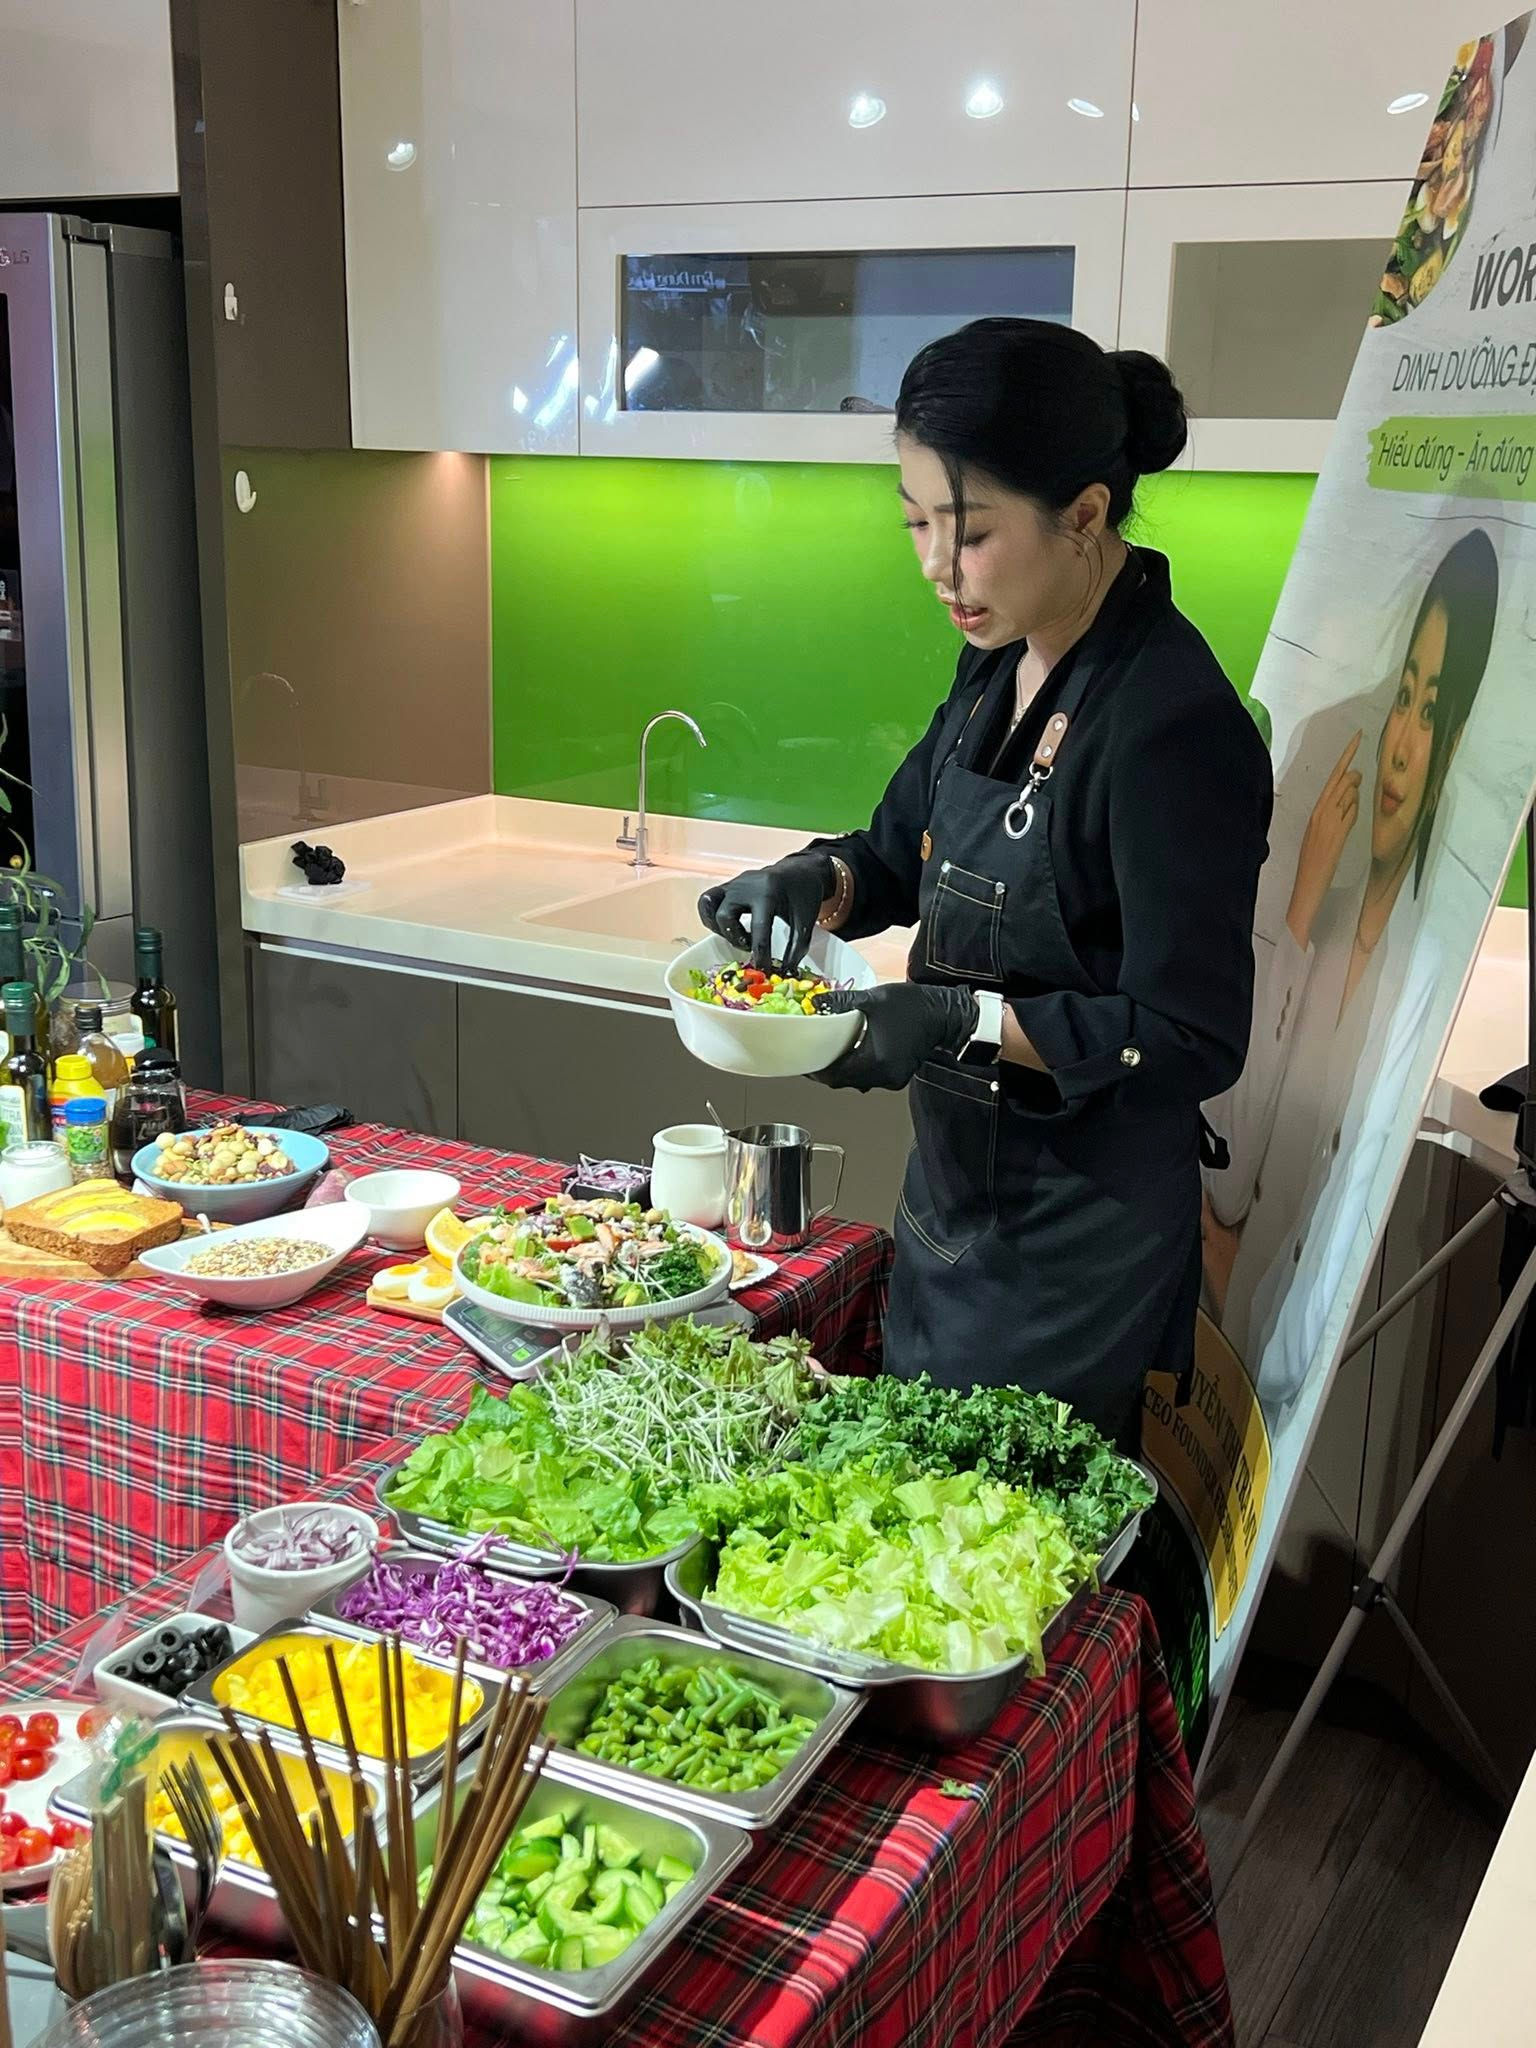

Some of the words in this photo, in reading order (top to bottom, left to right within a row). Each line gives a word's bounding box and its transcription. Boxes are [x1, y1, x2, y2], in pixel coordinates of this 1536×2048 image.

[1469, 242, 1536, 311] WOR
[1392, 353, 1444, 392] DINH
[1441, 336, 1518, 391] DƯỠNG
[1414, 435, 1456, 481] đúng
[1465, 430, 1489, 472] Ăn
[1490, 436, 1535, 486] đúng
[1144, 1386, 1173, 1426] CEO
[1172, 1411, 1218, 1491] FOUNDER
